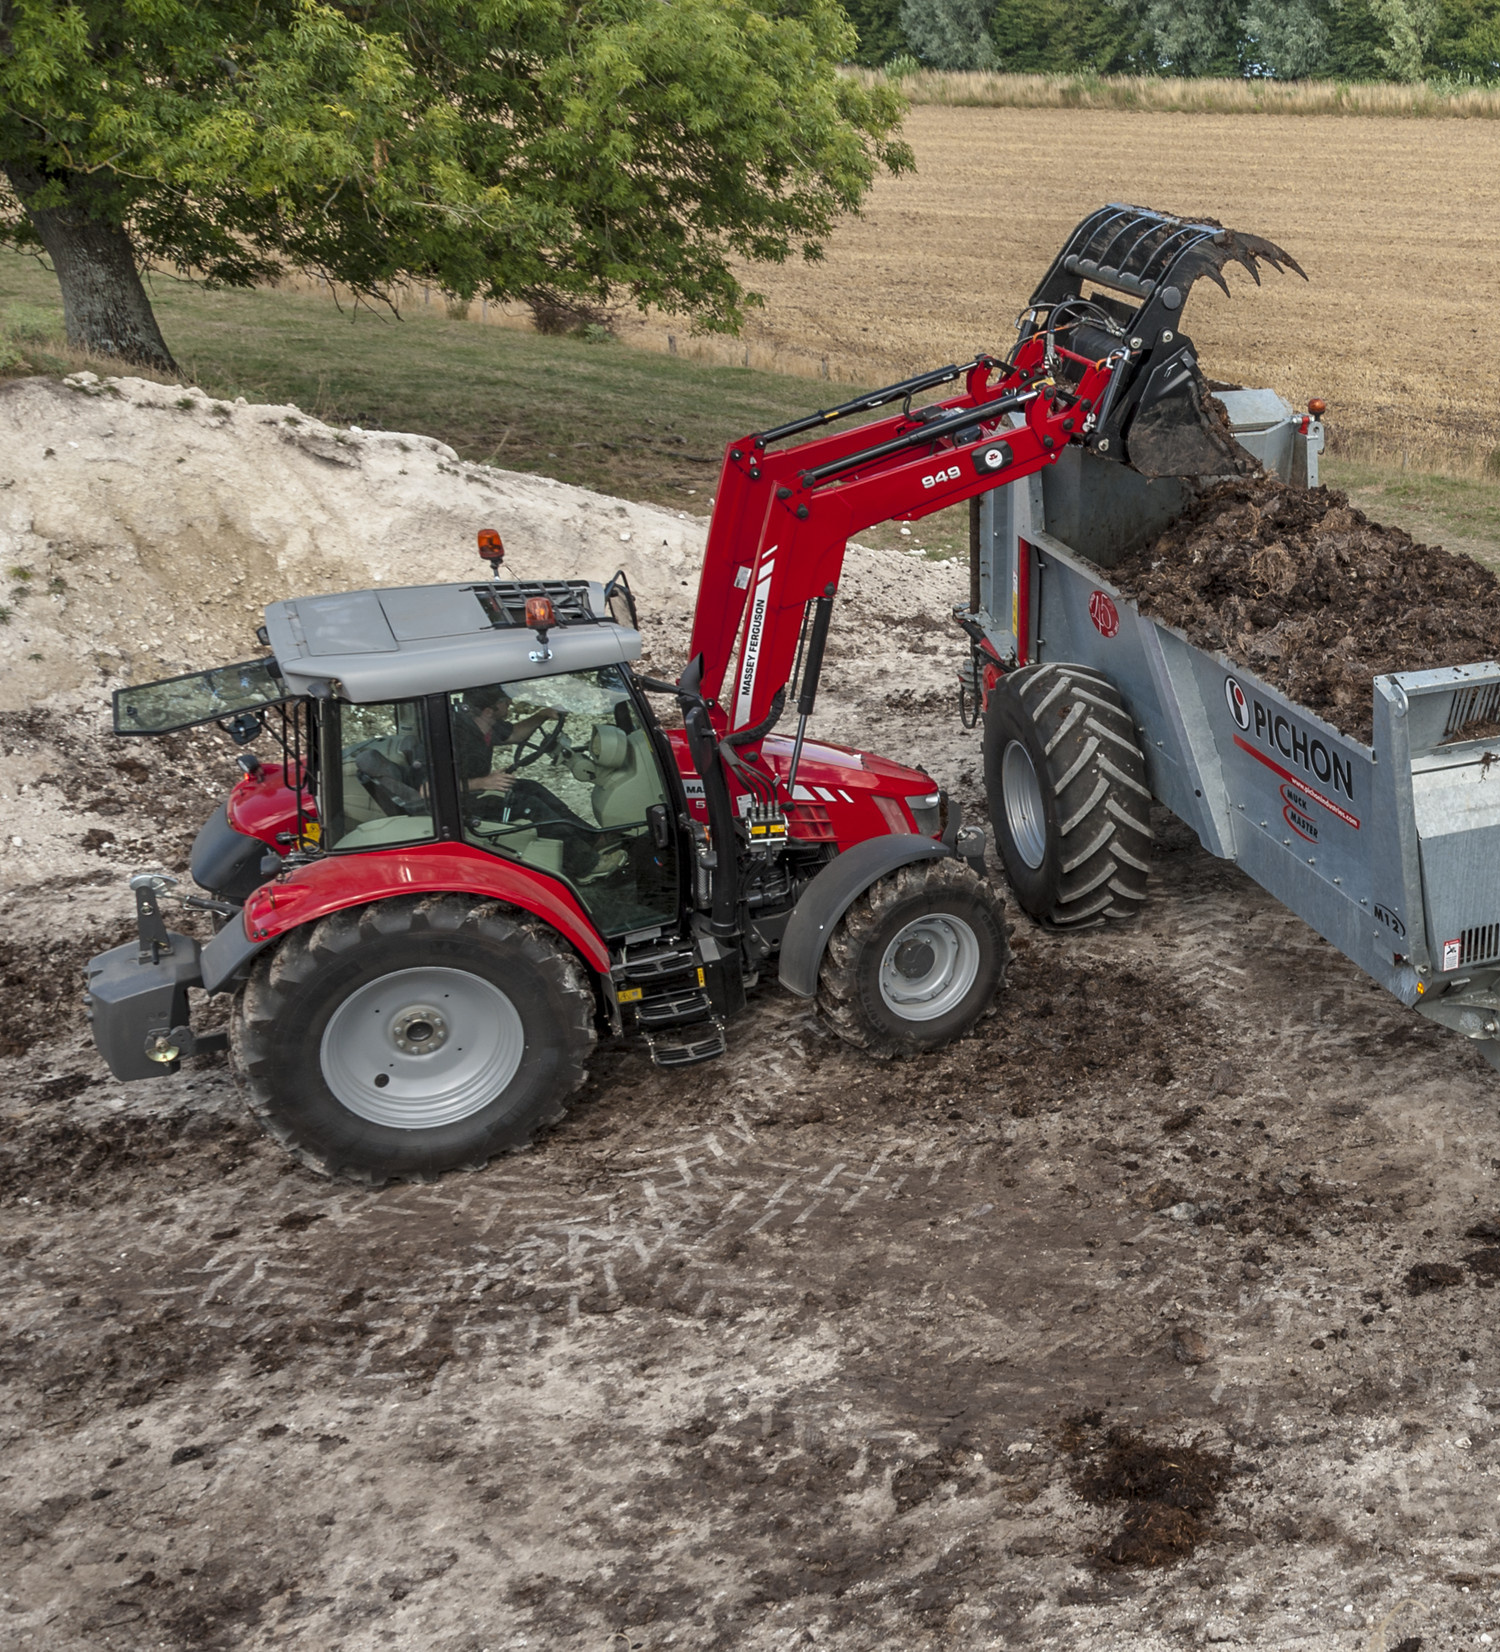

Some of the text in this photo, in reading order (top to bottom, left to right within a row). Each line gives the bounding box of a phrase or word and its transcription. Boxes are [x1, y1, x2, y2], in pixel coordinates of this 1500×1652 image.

[921, 466, 961, 489] 949
[742, 599, 765, 695] MASSEY FERGUSON
[1253, 700, 1354, 801] PICHON
[1287, 789, 1308, 811] MUCK
[1290, 811, 1319, 838] MASTER
[1374, 905, 1400, 935] M12
